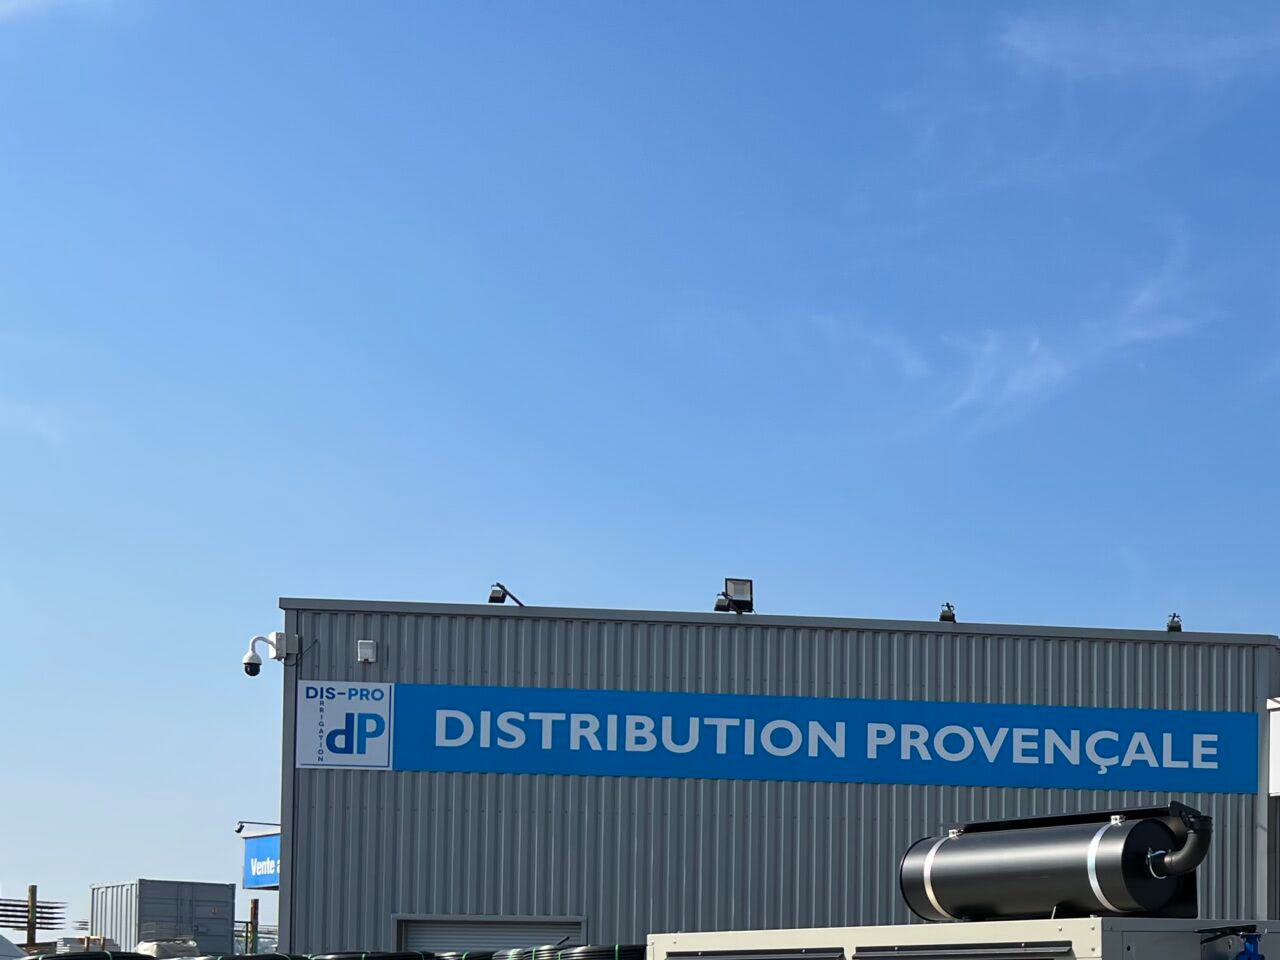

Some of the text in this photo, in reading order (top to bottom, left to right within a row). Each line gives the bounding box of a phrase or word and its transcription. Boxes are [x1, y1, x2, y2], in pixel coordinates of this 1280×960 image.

[305, 686, 385, 701] DIS-PRO
[435, 709, 1219, 774] DISTRIBUTION PROVENÇALE
[250, 857, 275, 876] Vente
